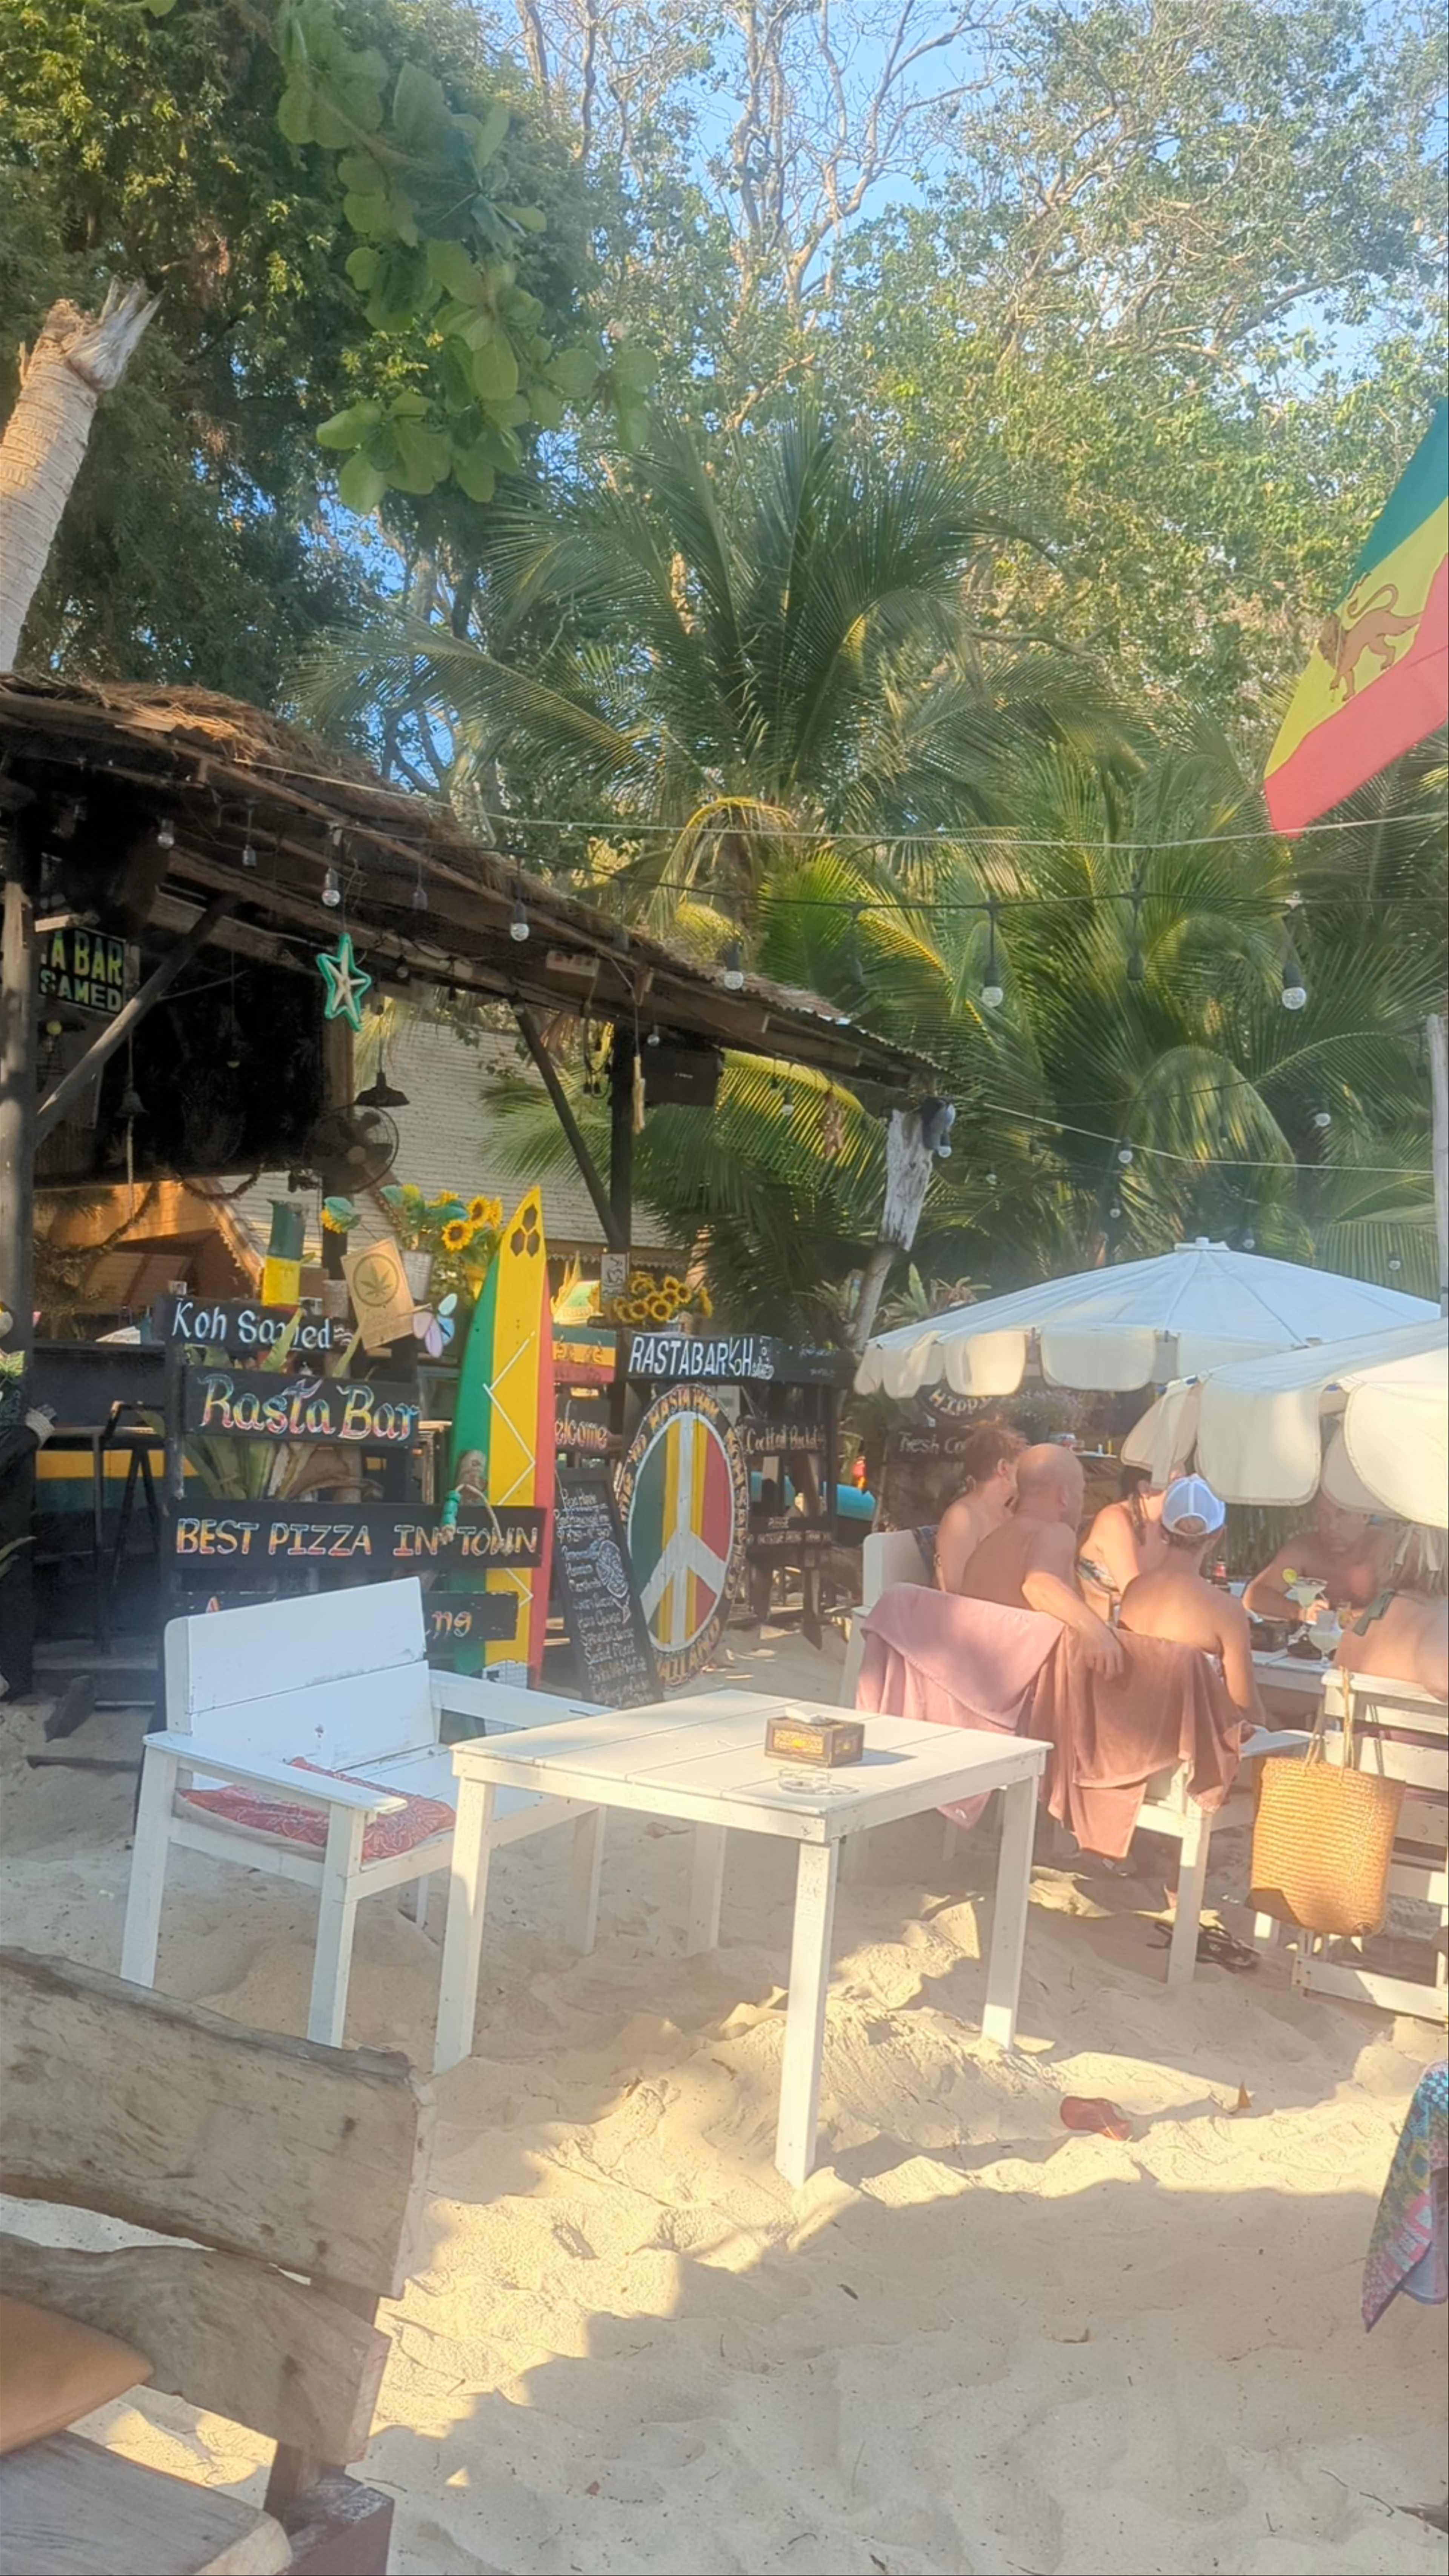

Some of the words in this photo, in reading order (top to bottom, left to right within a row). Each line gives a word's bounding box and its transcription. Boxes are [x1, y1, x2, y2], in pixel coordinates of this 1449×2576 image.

[75, 929, 122, 986] BAR
[40, 969, 122, 1012] SAMED
[172, 1300, 226, 1341] Koh
[197, 1373, 335, 1434] Rasta
[336, 1385, 421, 1441] Bar
[555, 1400, 608, 1450] elcome
[176, 1518, 259, 1555] BEST
[268, 1522, 372, 1556] PIZZA
[394, 1525, 439, 1556] IN
[455, 1526, 538, 1556] TOWN
